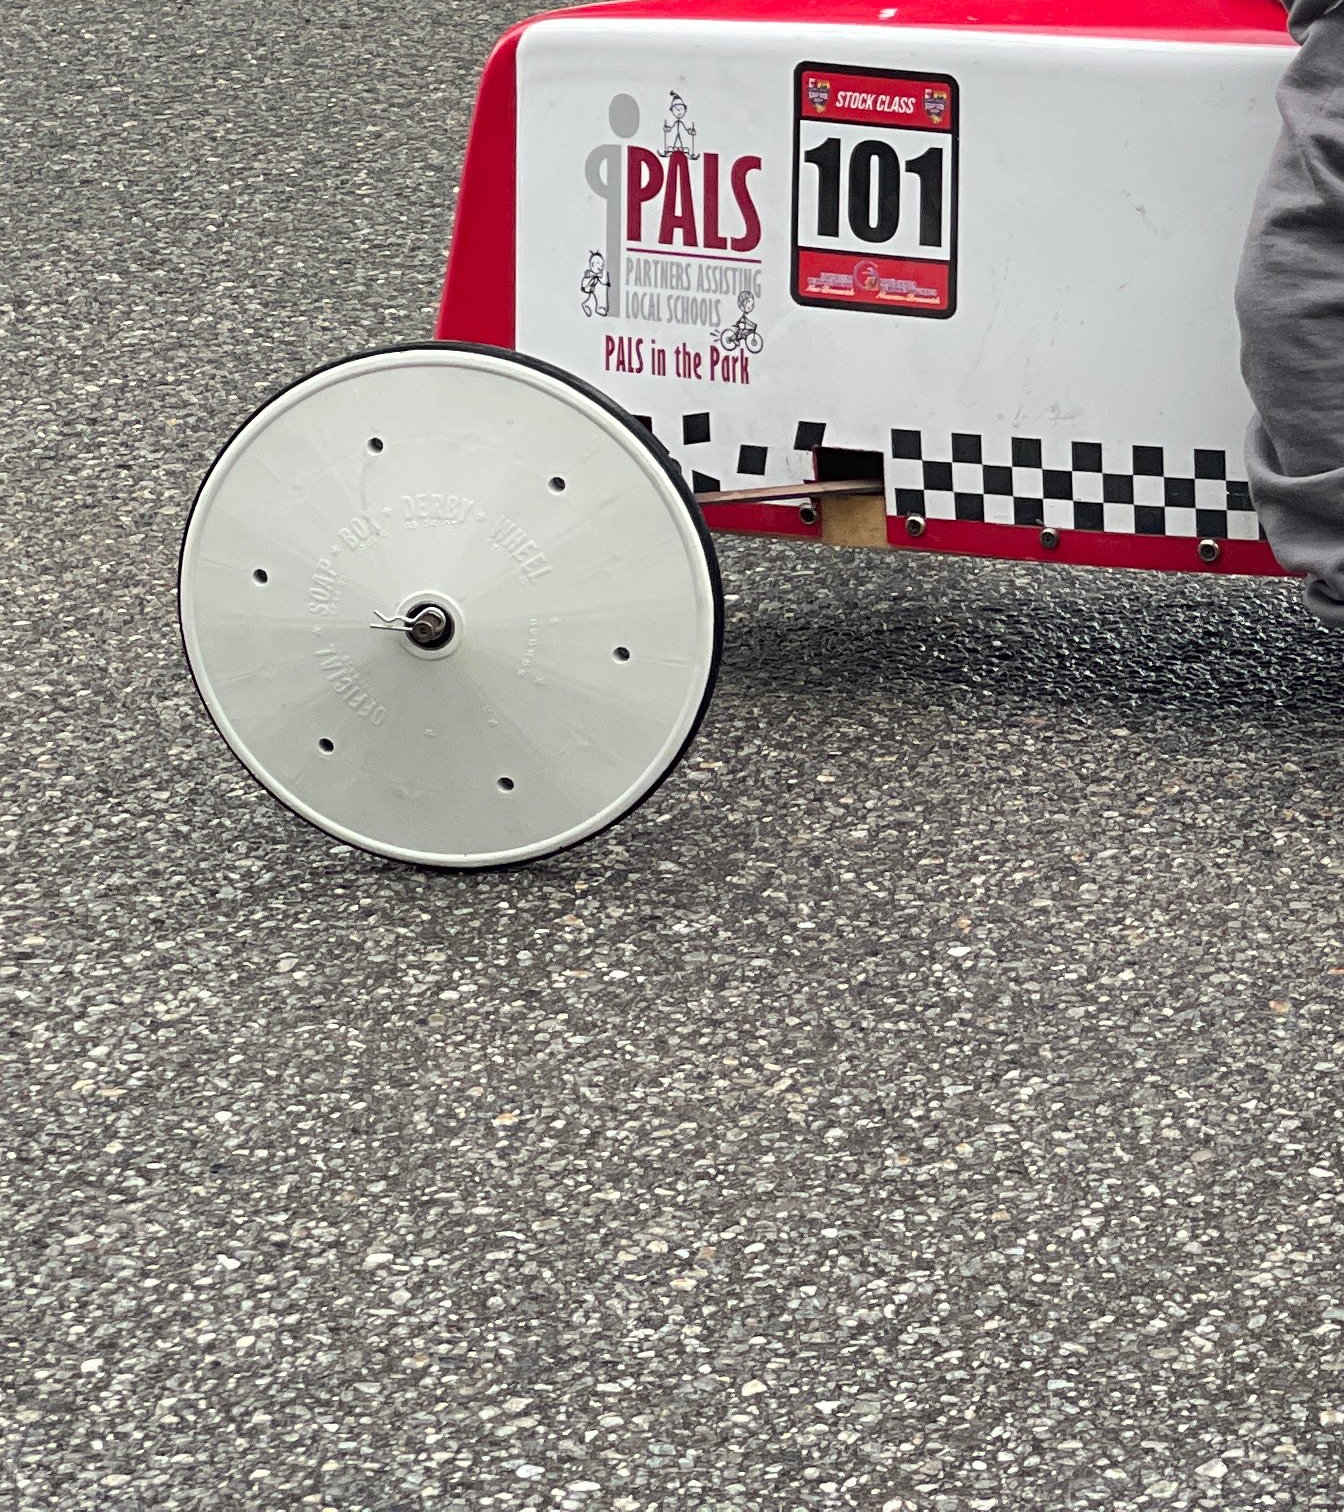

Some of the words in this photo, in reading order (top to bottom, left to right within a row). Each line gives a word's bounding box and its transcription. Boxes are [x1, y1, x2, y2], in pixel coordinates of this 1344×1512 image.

[836, 91, 876, 110] STOCK
[876, 94, 916, 114] CLASS
[627, 145, 762, 252] PALS
[804, 137, 943, 248] 101
[625, 257, 692, 292] PARTNERS
[696, 265, 762, 299] ASSISTING
[625, 290, 662, 322] LOCAL
[667, 294, 721, 327] SCHOOLS
[605, 335, 644, 375] PALS
[651, 339, 667, 377] in
[674, 342, 702, 380] the
[710, 345, 750, 385] Park
[308, 558, 338, 616] SOAP
[400, 493, 475, 520] DERBY
[490, 515, 553, 583] WHEEL
